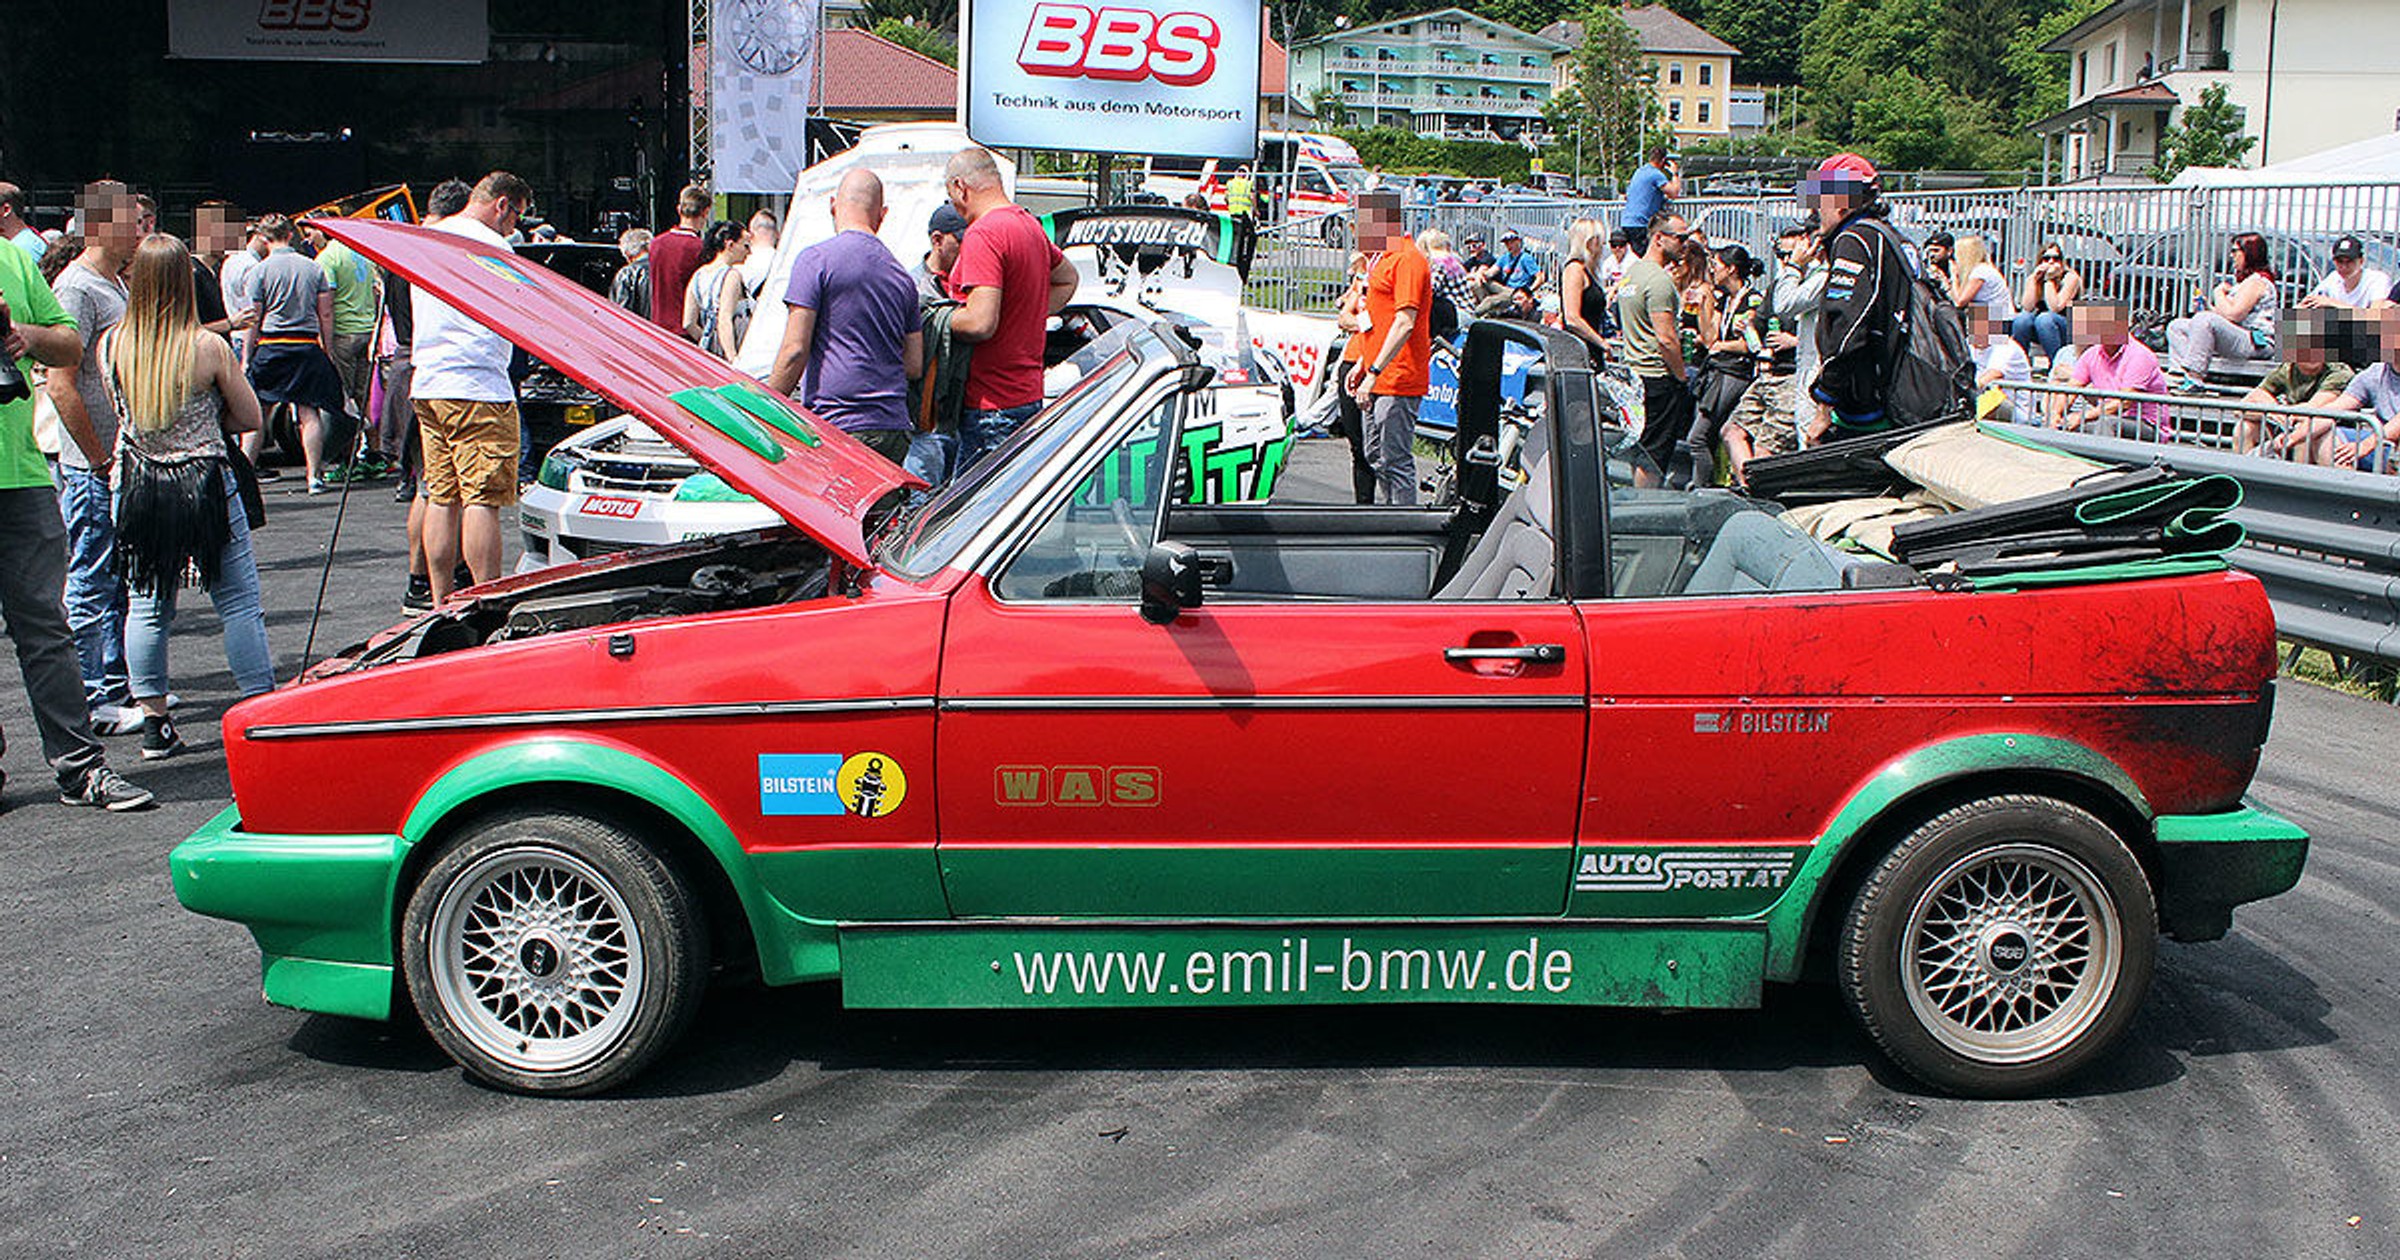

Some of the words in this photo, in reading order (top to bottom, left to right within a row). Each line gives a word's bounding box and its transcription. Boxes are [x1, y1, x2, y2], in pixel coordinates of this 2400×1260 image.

[258, 0, 371, 32] BBS
[1016, 2, 1221, 87] BBS
[992, 92, 1059, 110] Technik
[1064, 99, 1096, 113] aus
[1101, 101, 1140, 115] dem
[1144, 104, 1242, 122] Motorsport
[1065, 218, 1209, 246] RP-TOOLS.COM
[582, 497, 639, 517] MOTUL
[1741, 712, 1831, 733] BILSTEIN
[762, 776, 835, 794] BILSTEIN
[1013, 937, 1573, 995] www.emil-bmw.de
